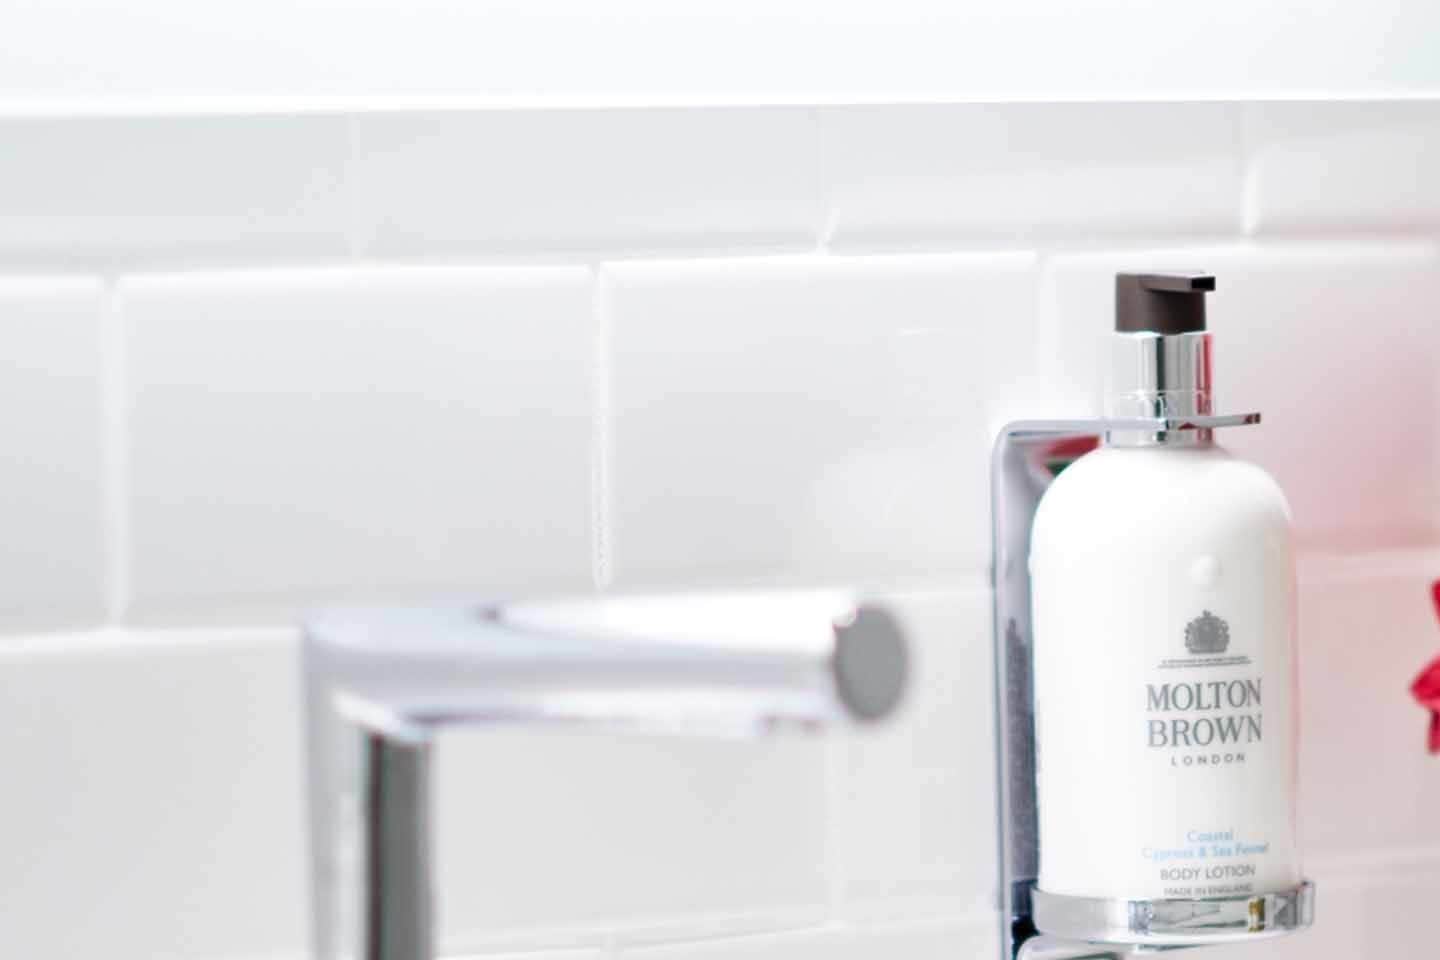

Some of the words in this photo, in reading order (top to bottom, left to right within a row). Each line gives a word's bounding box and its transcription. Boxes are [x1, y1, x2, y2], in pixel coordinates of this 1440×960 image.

[1145, 678, 1262, 711] MOLTON
[1146, 714, 1262, 747] BROWN
[1171, 753, 1245, 766] LONDON
[1160, 867, 1200, 880] BODY
[1205, 863, 1256, 879] LOTION
